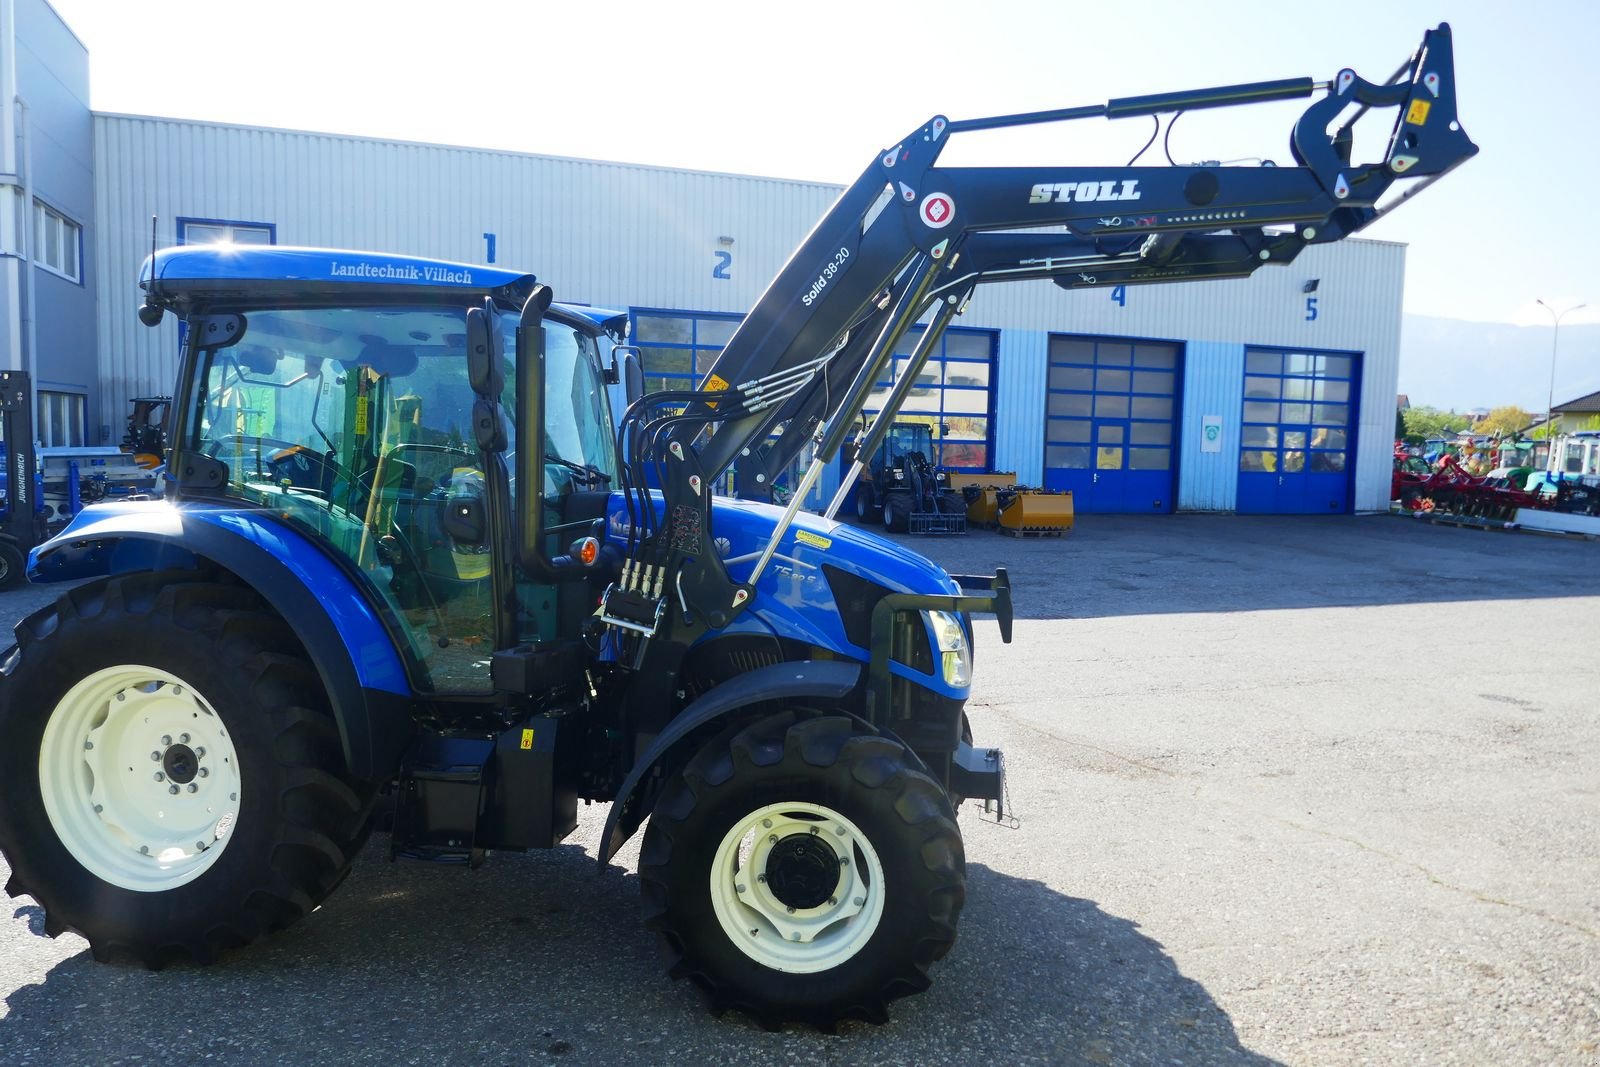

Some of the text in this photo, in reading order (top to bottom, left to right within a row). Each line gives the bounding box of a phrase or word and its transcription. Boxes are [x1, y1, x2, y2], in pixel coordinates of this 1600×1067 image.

[1029, 180, 1141, 204] STOLL
[483, 233, 496, 263] 1
[331, 262, 472, 284] Landtechnik-Villach
[713, 251, 731, 279] 2
[802, 247, 850, 306] Solid 38-20
[1111, 285, 1125, 306] 4
[1305, 298, 1317, 320] 5
